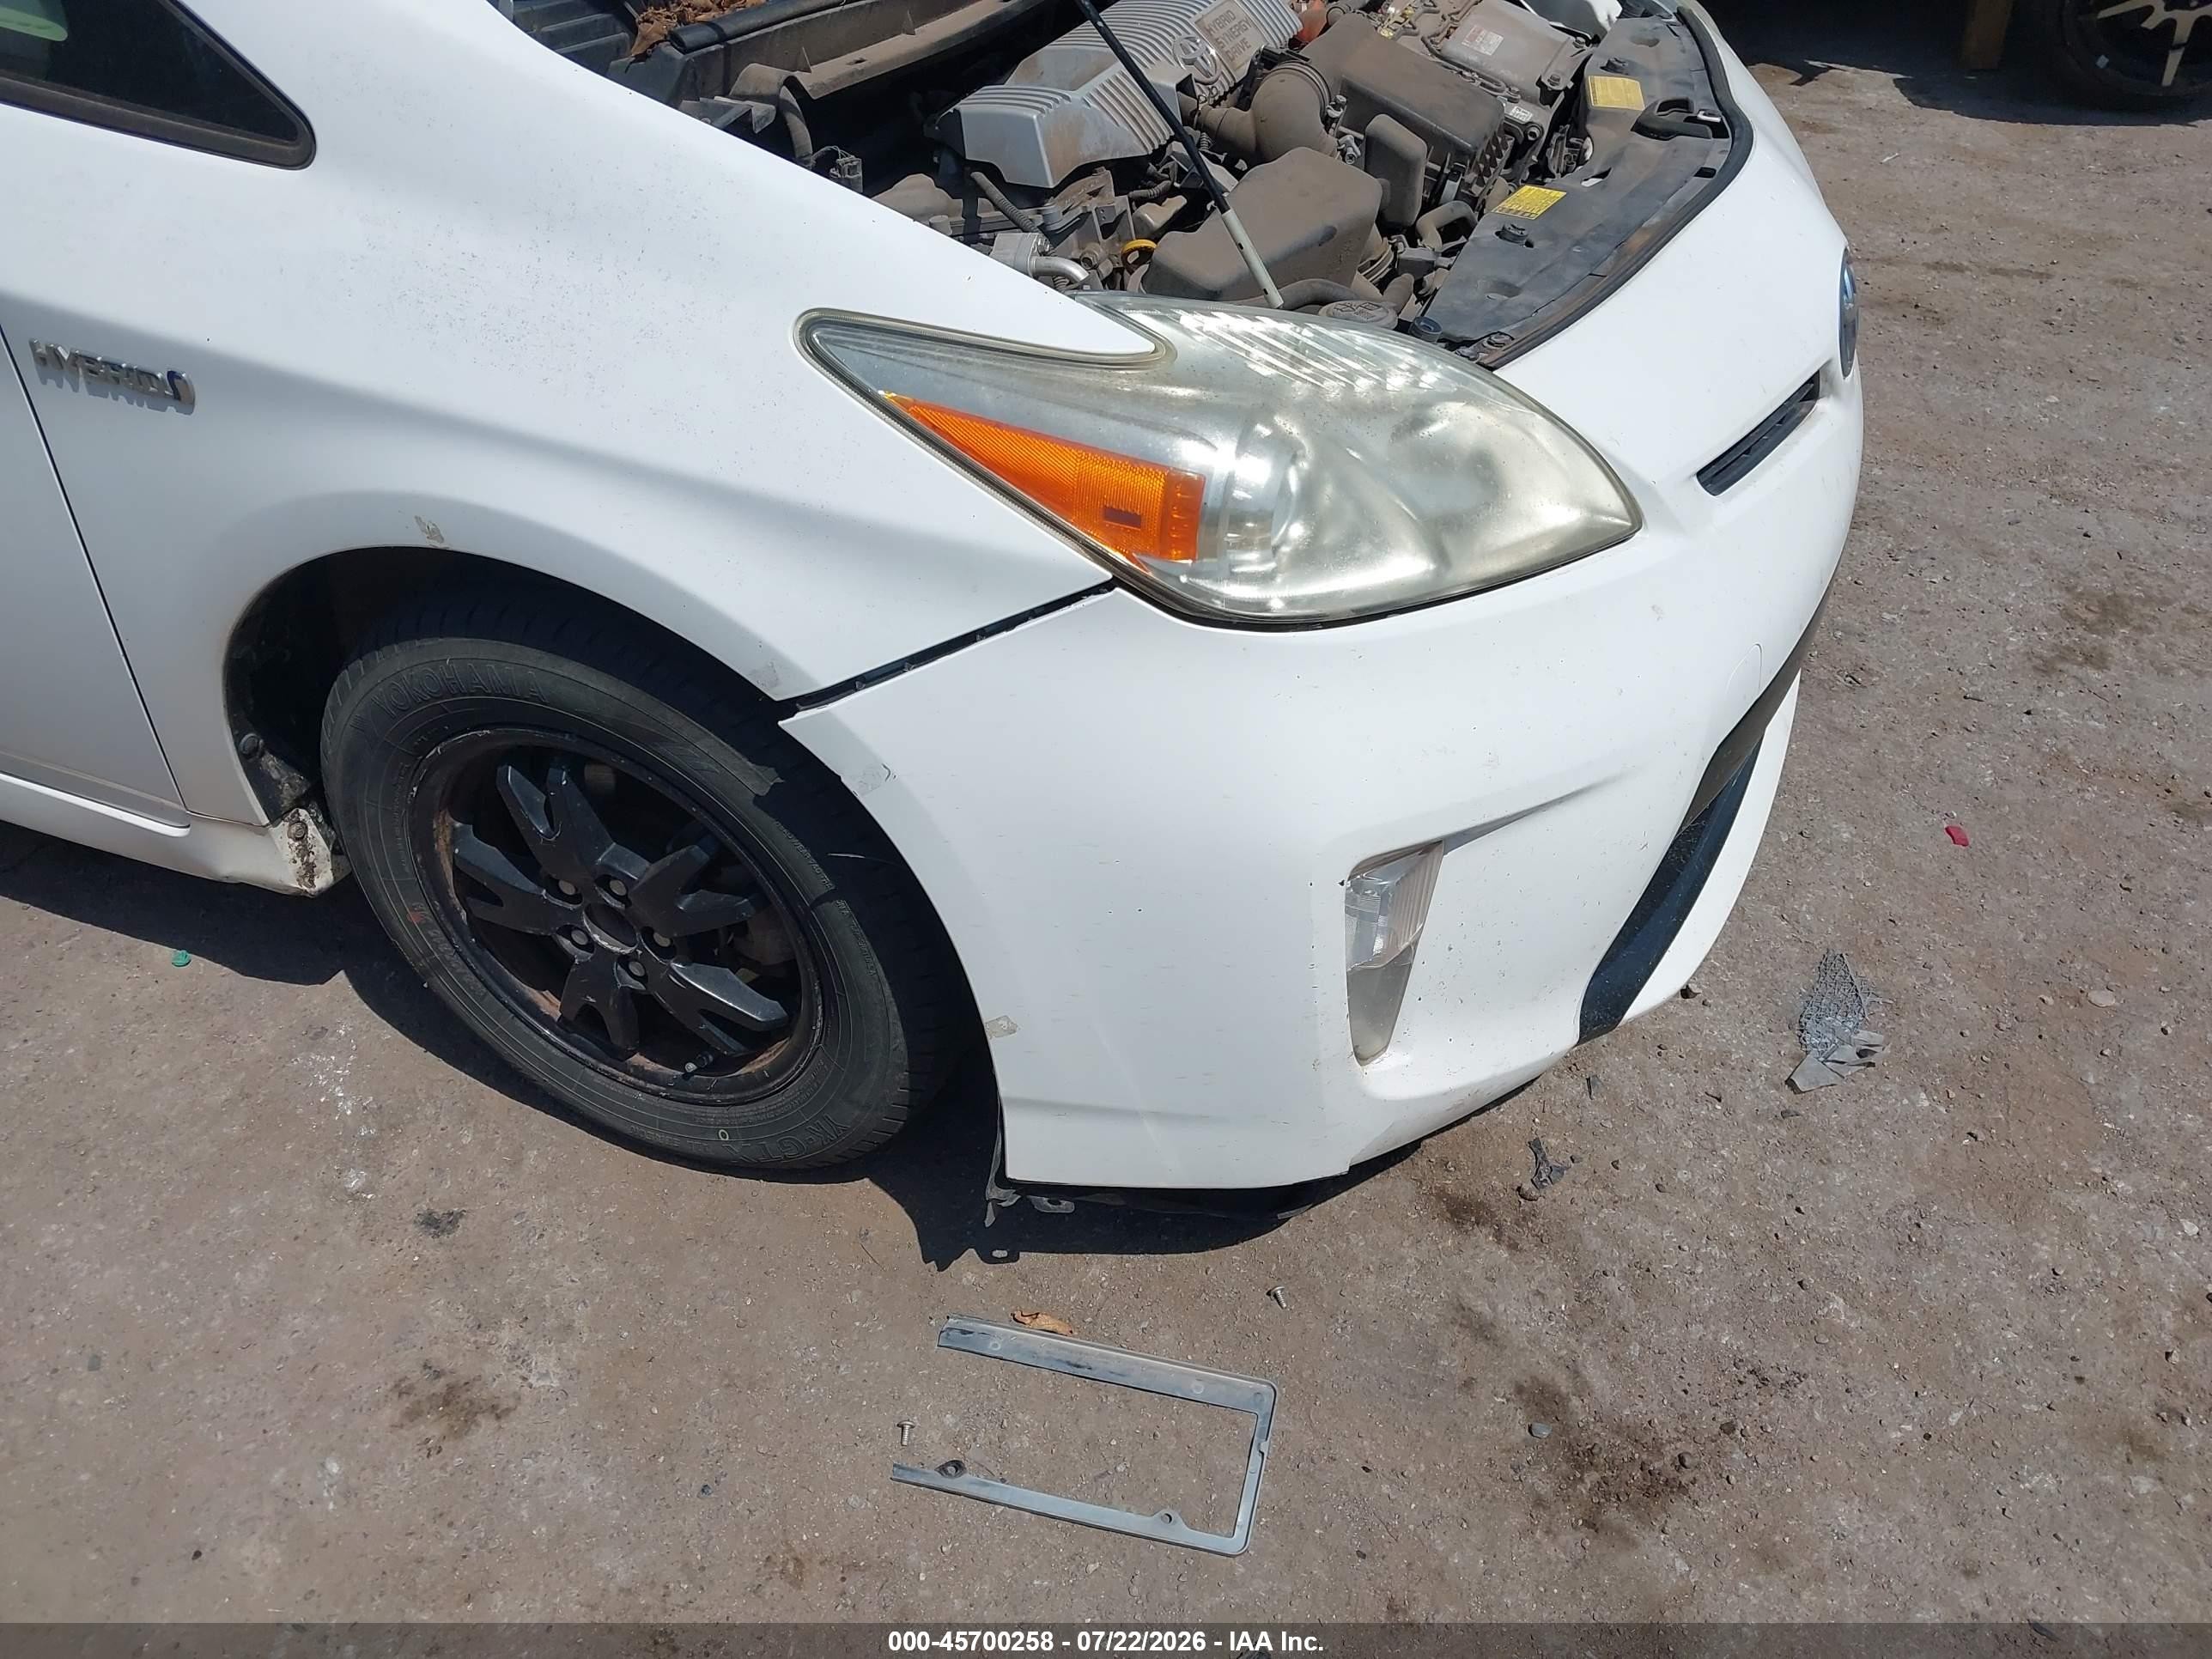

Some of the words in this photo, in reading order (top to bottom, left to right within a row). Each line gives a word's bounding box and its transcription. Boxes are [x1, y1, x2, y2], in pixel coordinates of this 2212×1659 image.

[1204, 9, 1237, 36] HYBRID
[1215, 17, 1252, 49] SYNERGY
[1225, 37, 1251, 62] DRIVE
[370, 661, 549, 718] YOKOHAMA
